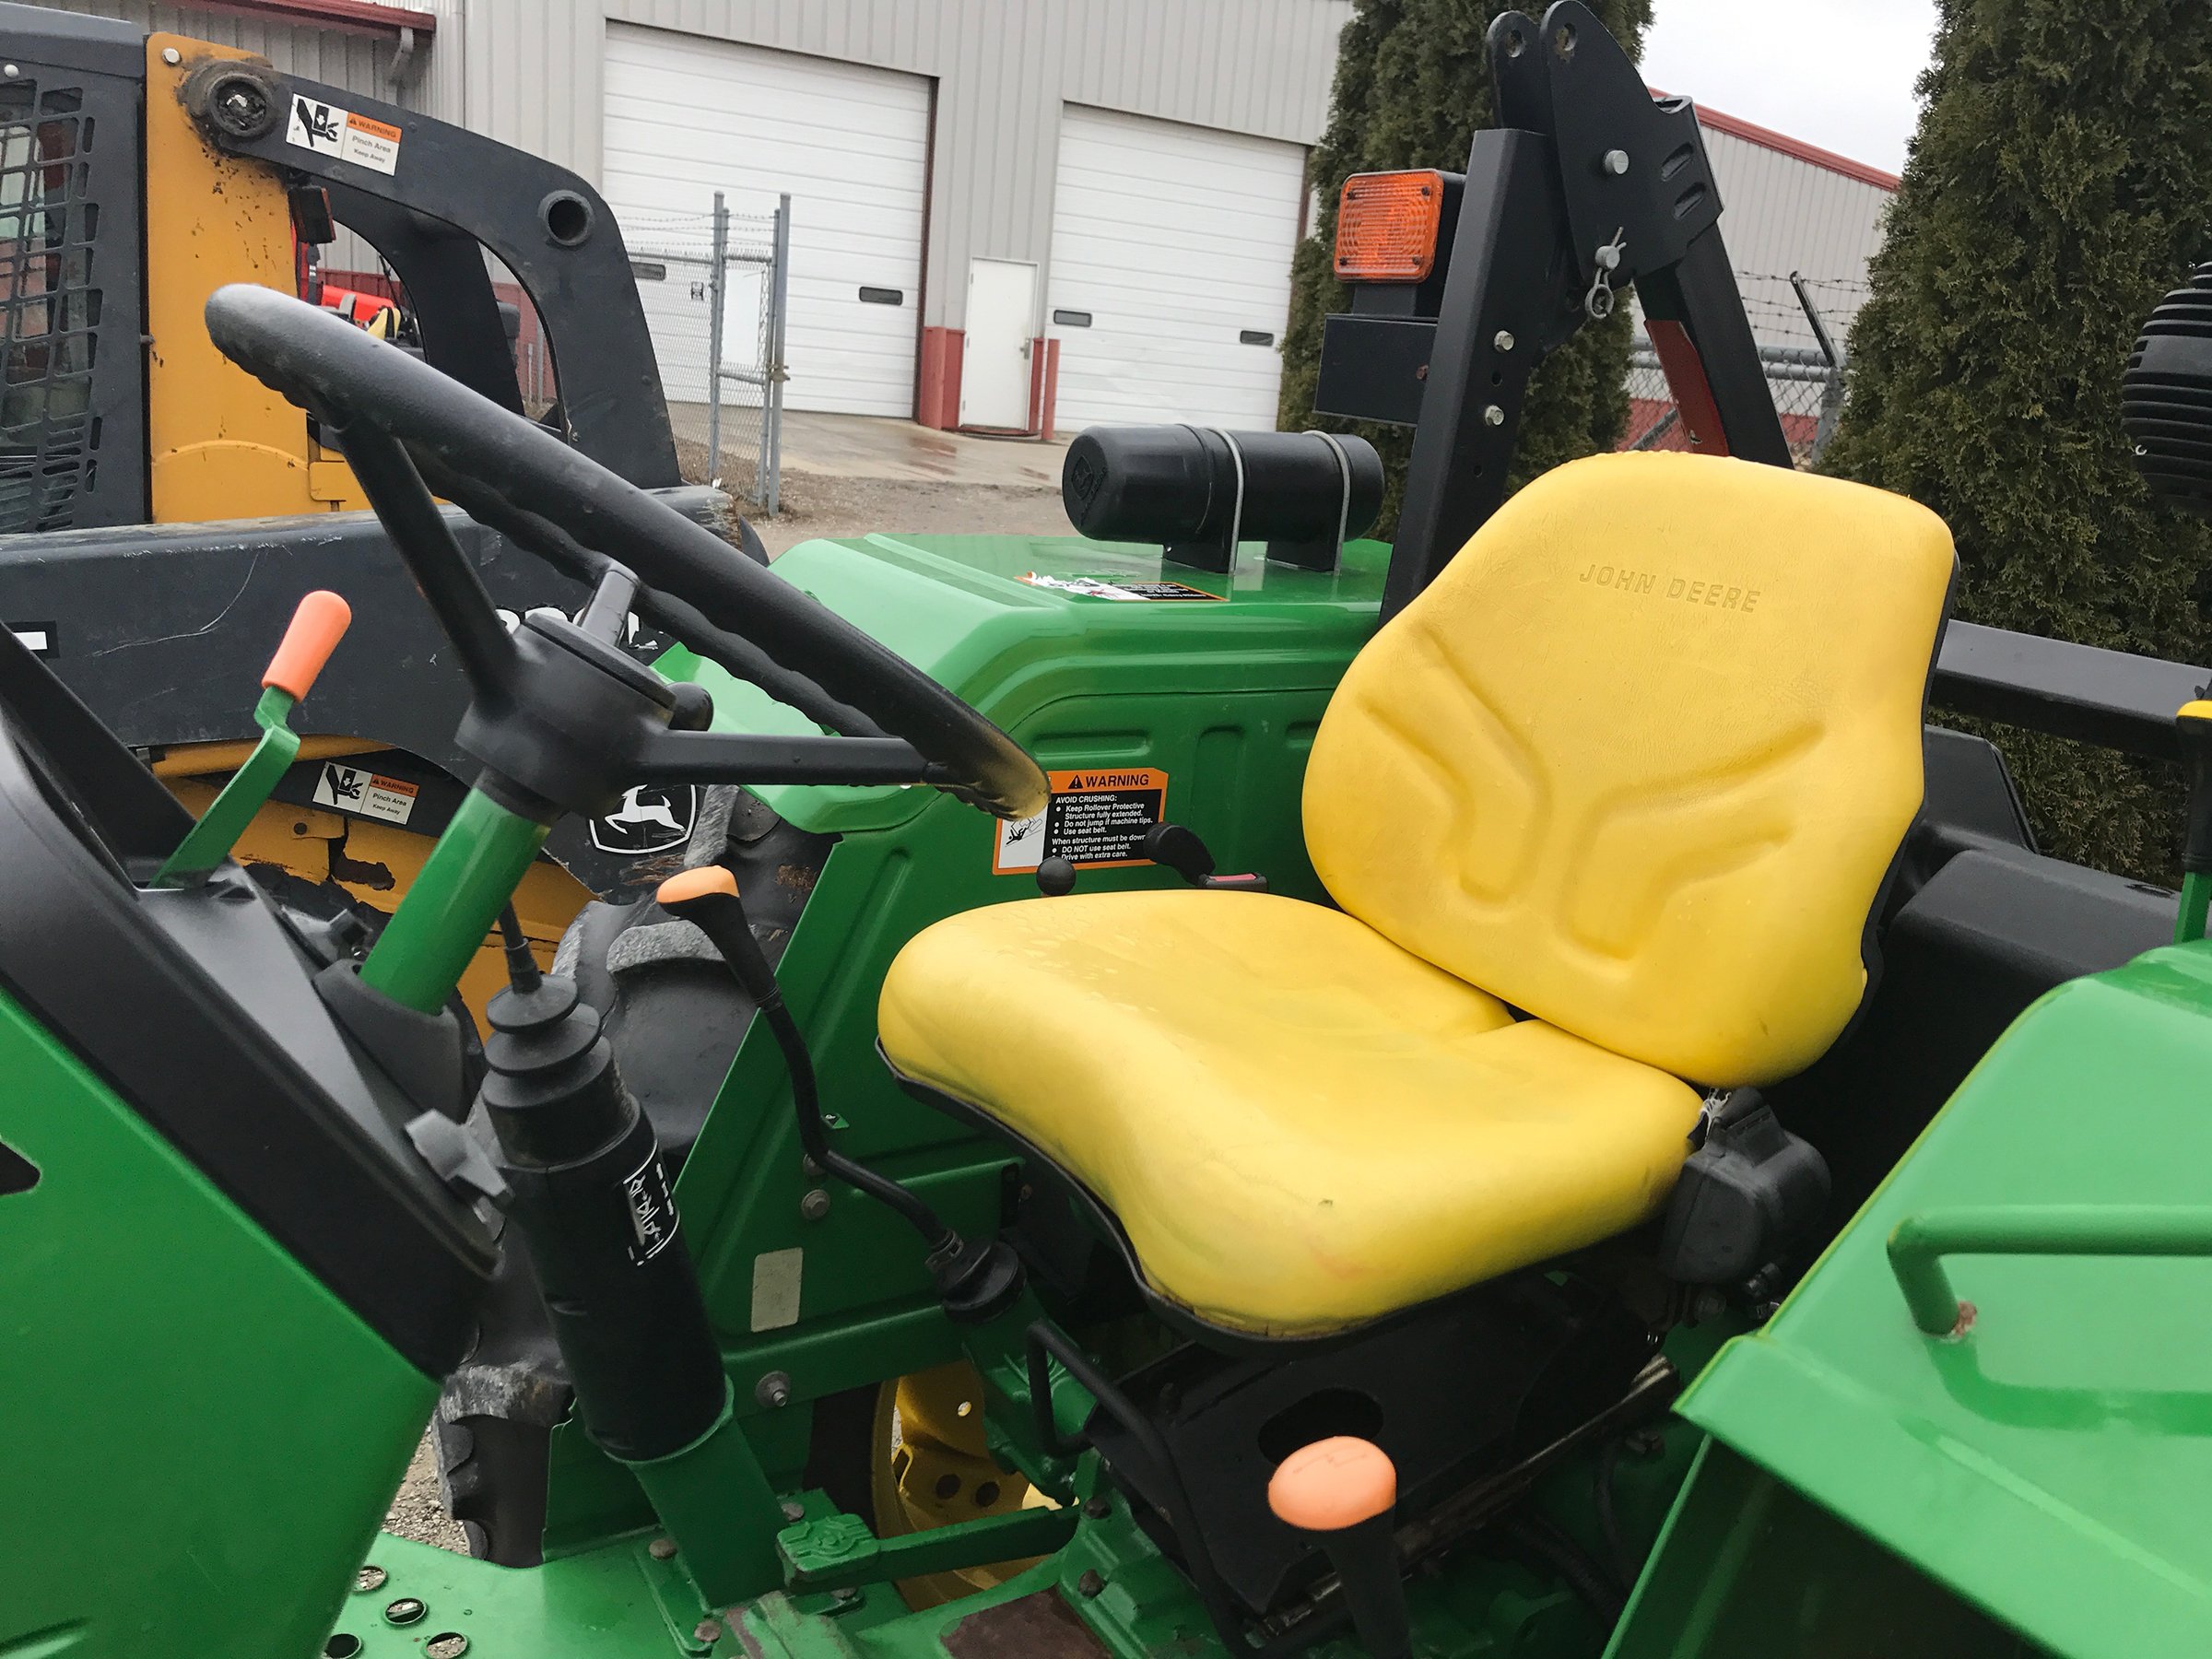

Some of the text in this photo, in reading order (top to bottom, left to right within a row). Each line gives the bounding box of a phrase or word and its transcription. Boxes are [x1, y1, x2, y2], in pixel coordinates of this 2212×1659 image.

[359, 121, 396, 138] WARNING
[352, 135, 391, 153] Pinch Area
[354, 148, 385, 163] Keep Away
[1579, 564, 1761, 613] JOHN DEERE
[381, 780, 414, 794] WARNING
[1085, 774, 1149, 787] WARNING
[372, 793, 407, 806] Pinch Area
[1055, 794, 1117, 804] AVOID CRUSHING:
[386, 806, 400, 815] Away
[1065, 805, 1083, 813] Keep
[1112, 802, 1145, 810] Protective
[1065, 809, 1143, 820] Structure fully extended.
[1087, 819, 1104, 828] jump
[1104, 818, 1111, 826] if
[1139, 817, 1153, 825] tips.
[1061, 853, 1078, 861] Drive
